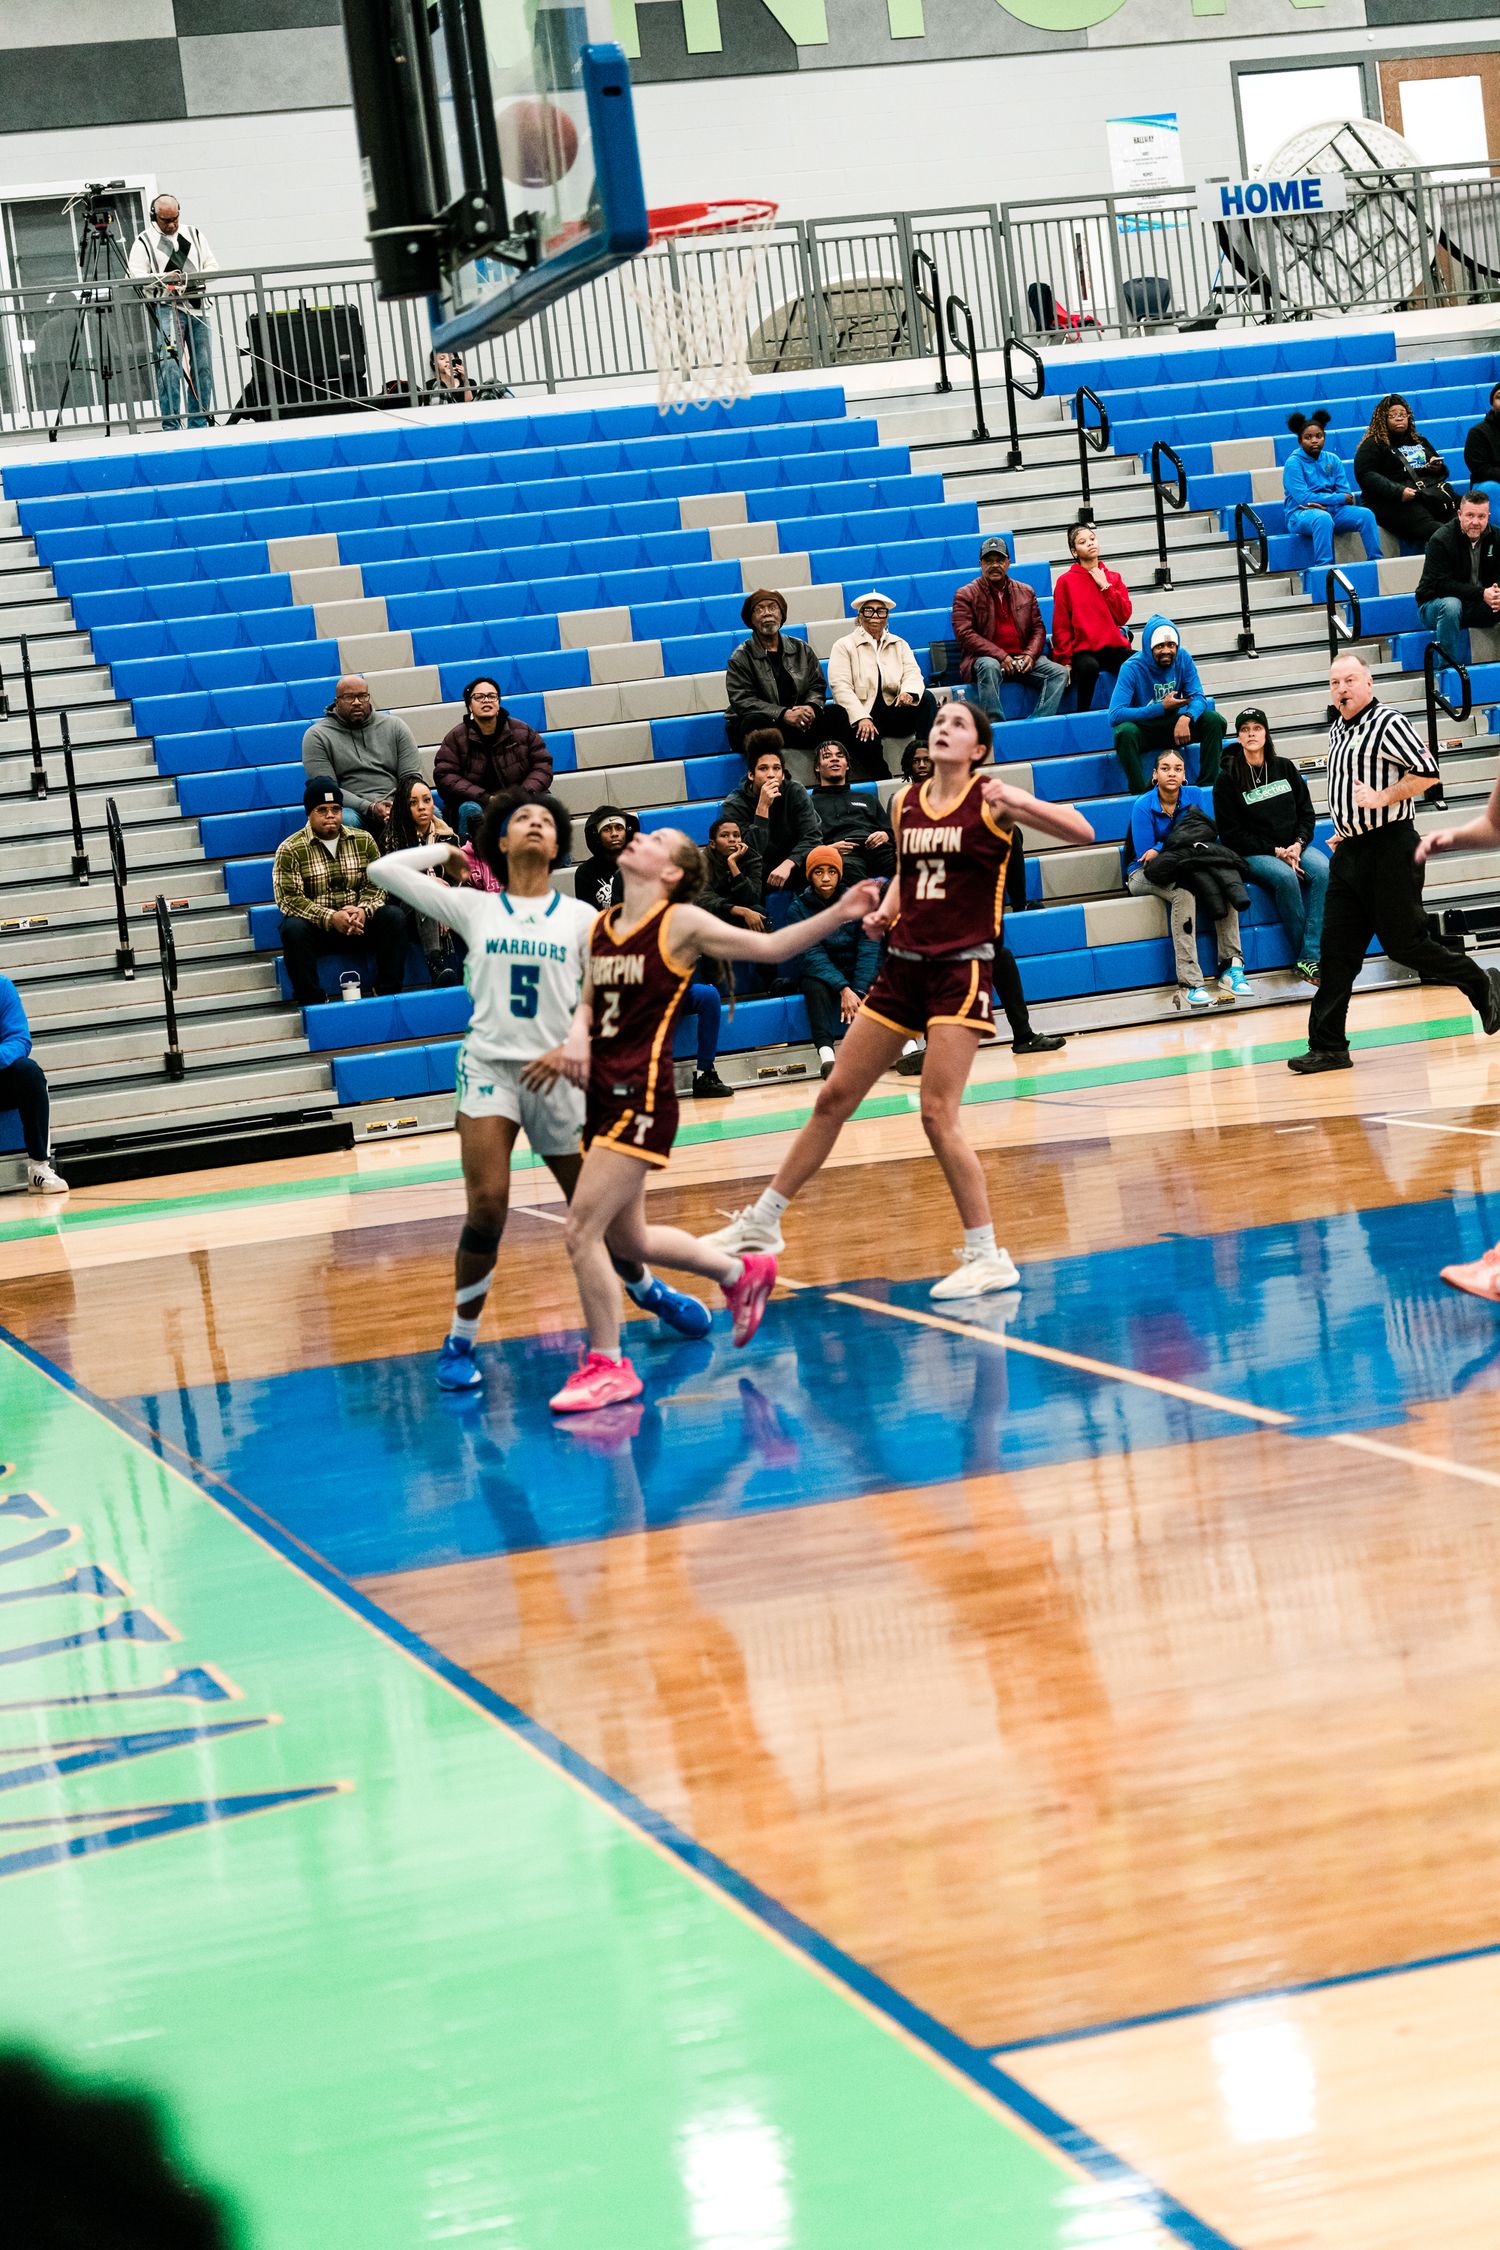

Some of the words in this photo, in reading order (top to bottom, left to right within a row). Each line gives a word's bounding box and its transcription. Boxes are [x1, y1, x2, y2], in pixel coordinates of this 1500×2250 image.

[1220, 178, 1323, 216] HOME
[1255, 783, 1290, 800] Section
[902, 826, 963, 854] TURPIN
[915, 859, 946, 899] 12
[486, 938, 567, 963] WARRIORS
[510, 964, 540, 1019] 5
[601, 991, 620, 1038] 2
